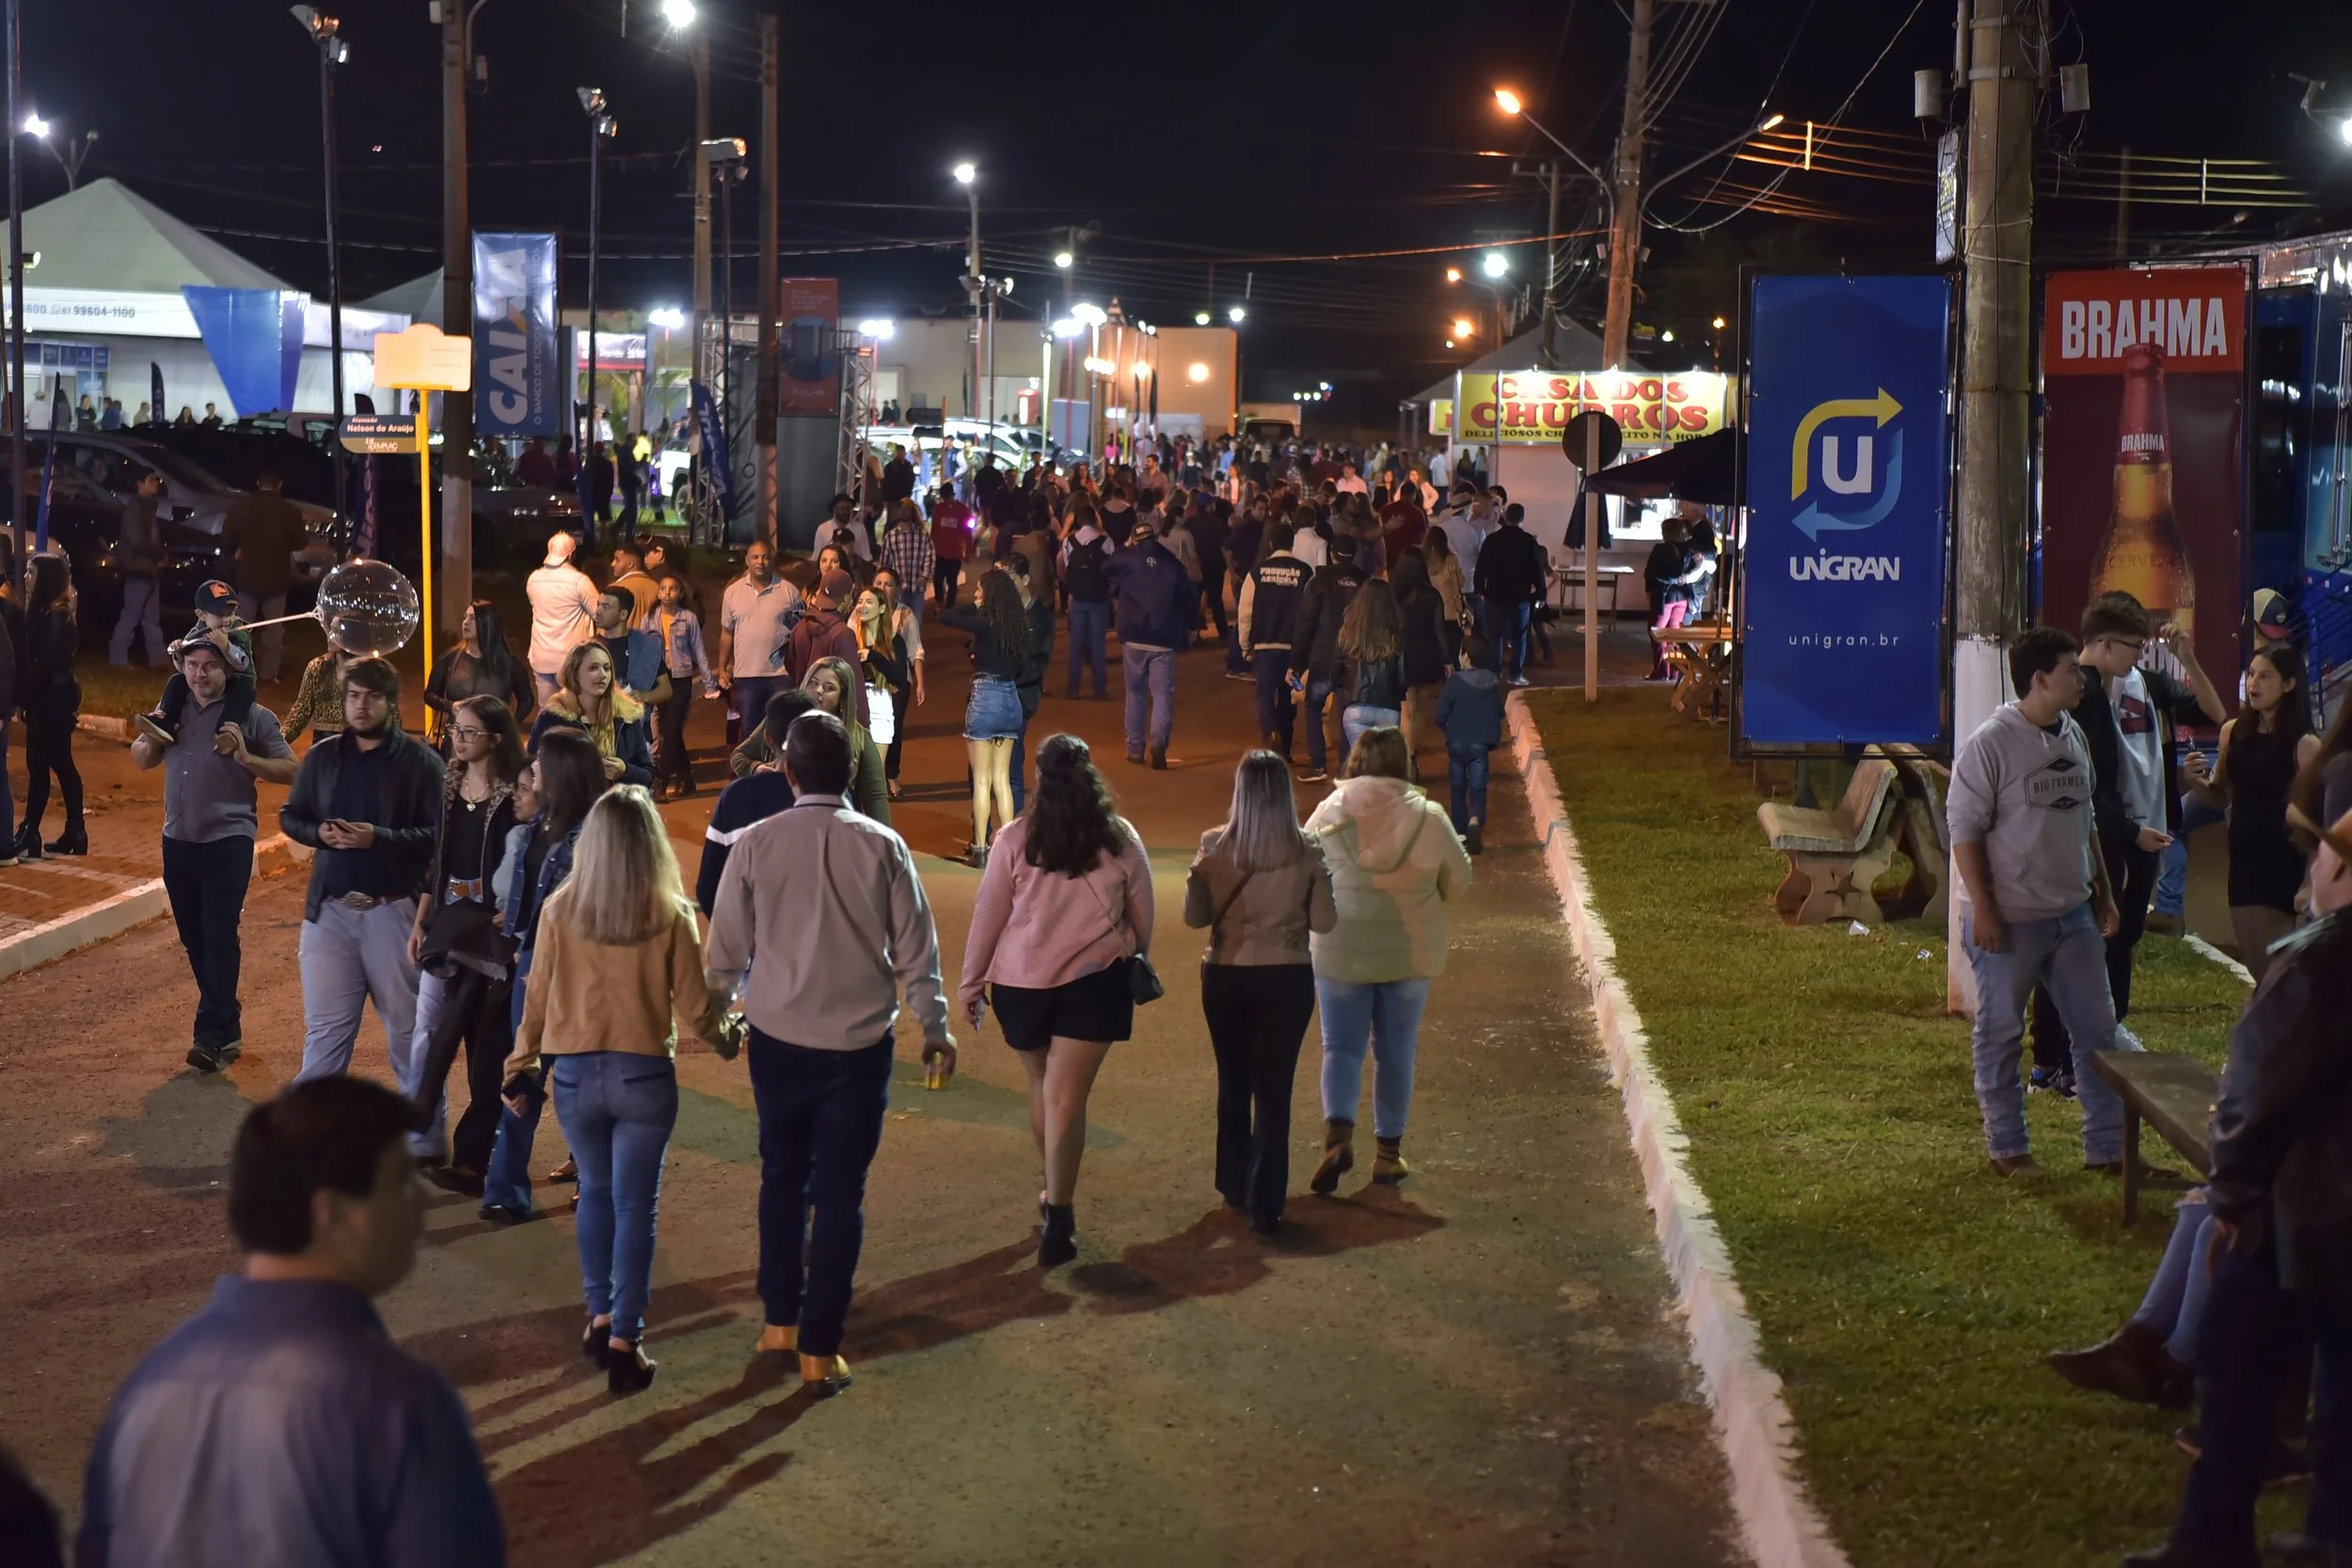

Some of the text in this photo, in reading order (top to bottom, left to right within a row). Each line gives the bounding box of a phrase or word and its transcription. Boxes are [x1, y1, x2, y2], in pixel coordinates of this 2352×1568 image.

[487, 247, 529, 424] CAIXA
[2061, 297, 2228, 359] BRAHMA
[533, 361, 543, 375] DE
[533, 378, 543, 413] BANCO
[1491, 377, 1689, 403] CSA DOS
[346, 423, 415, 434] Nelson de Araújo
[533, 416, 543, 425] O
[1465, 429, 1542, 438] DELIIOSOS
[1652, 432, 1673, 441] NA
[1675, 434, 1710, 442] HOR
[2121, 434, 2165, 452] BRAHMA
[1788, 632, 1899, 649] unigran.br
